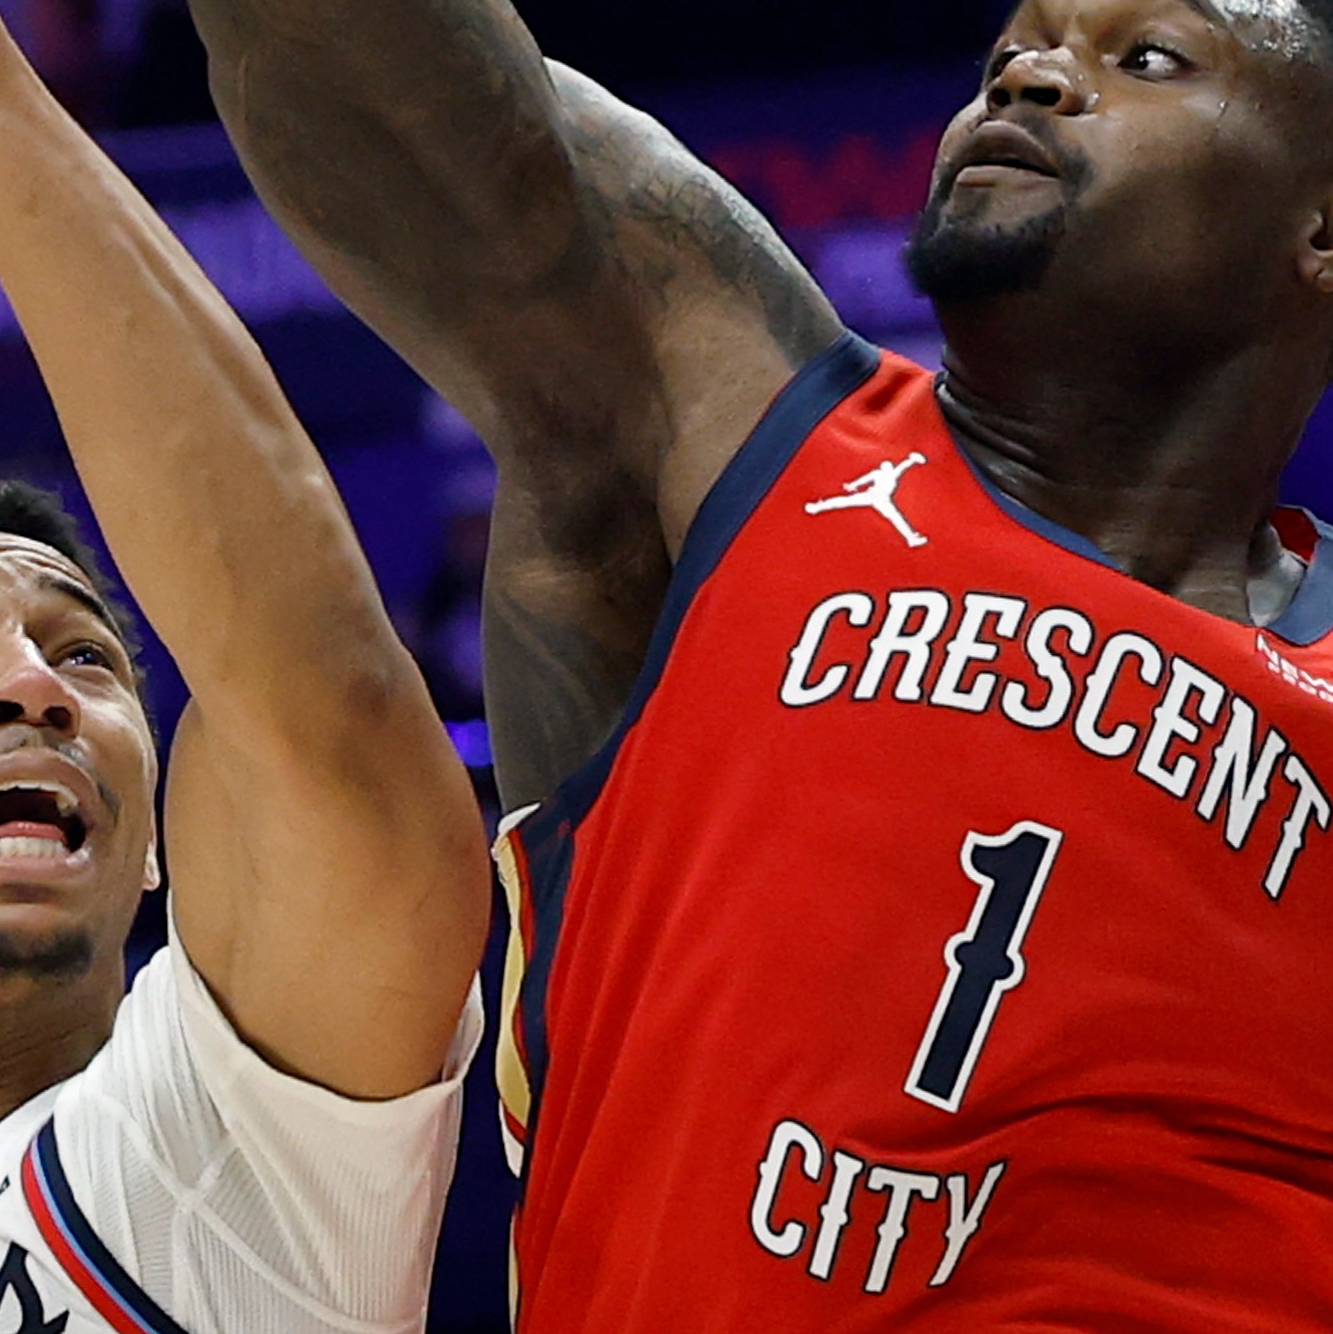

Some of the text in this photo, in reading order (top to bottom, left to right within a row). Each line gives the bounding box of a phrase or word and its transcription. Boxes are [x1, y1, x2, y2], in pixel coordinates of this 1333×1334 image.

[779, 589, 1333, 900] CRESCENT
[904, 819, 1064, 1115] 1
[750, 1119, 1007, 1294] CITY
